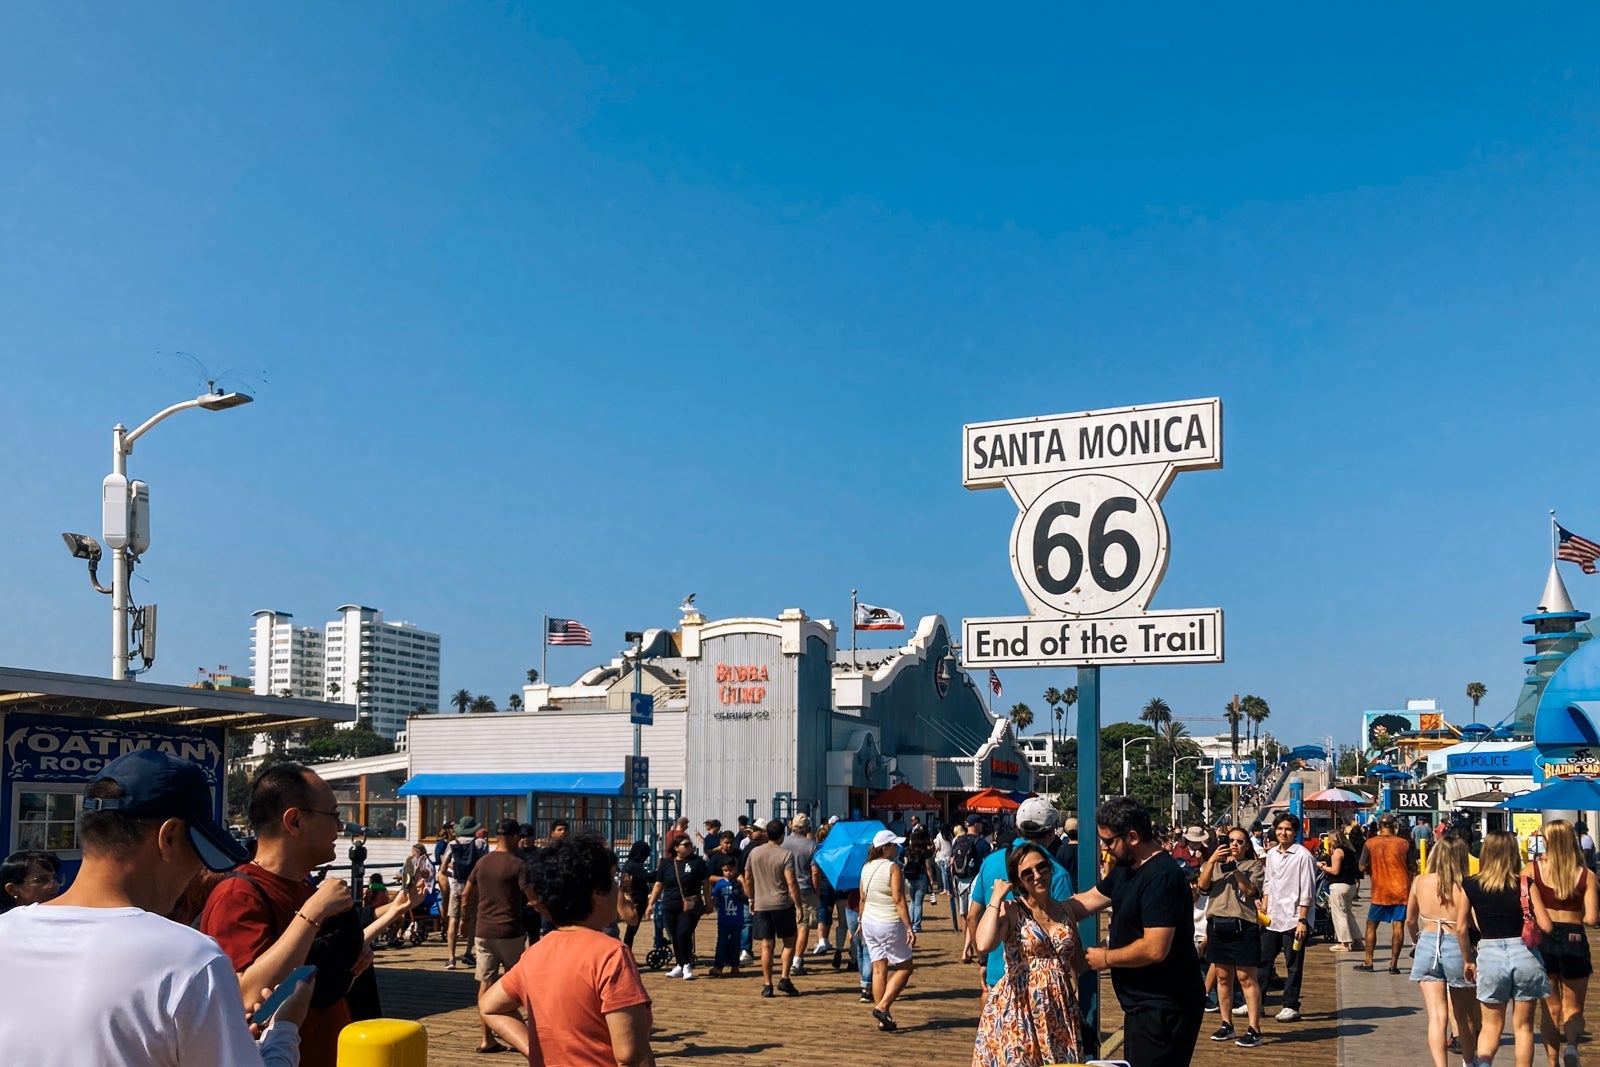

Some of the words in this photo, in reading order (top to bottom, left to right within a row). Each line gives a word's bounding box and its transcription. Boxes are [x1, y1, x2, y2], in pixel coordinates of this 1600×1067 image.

[973, 428, 1067, 470] SANTA
[1079, 414, 1207, 460] MONICA
[1032, 496, 1141, 595] 66
[976, 626, 1028, 657] End
[1040, 624, 1070, 655] of
[1081, 623, 1128, 654] the
[1138, 619, 1205, 652] Trail
[718, 684, 766, 704] GUMP
[40, 756, 112, 772] ROC
[1544, 763, 1580, 779] BLAZING
[1399, 793, 1432, 808] BAR
[724, 895, 738, 916] LA
